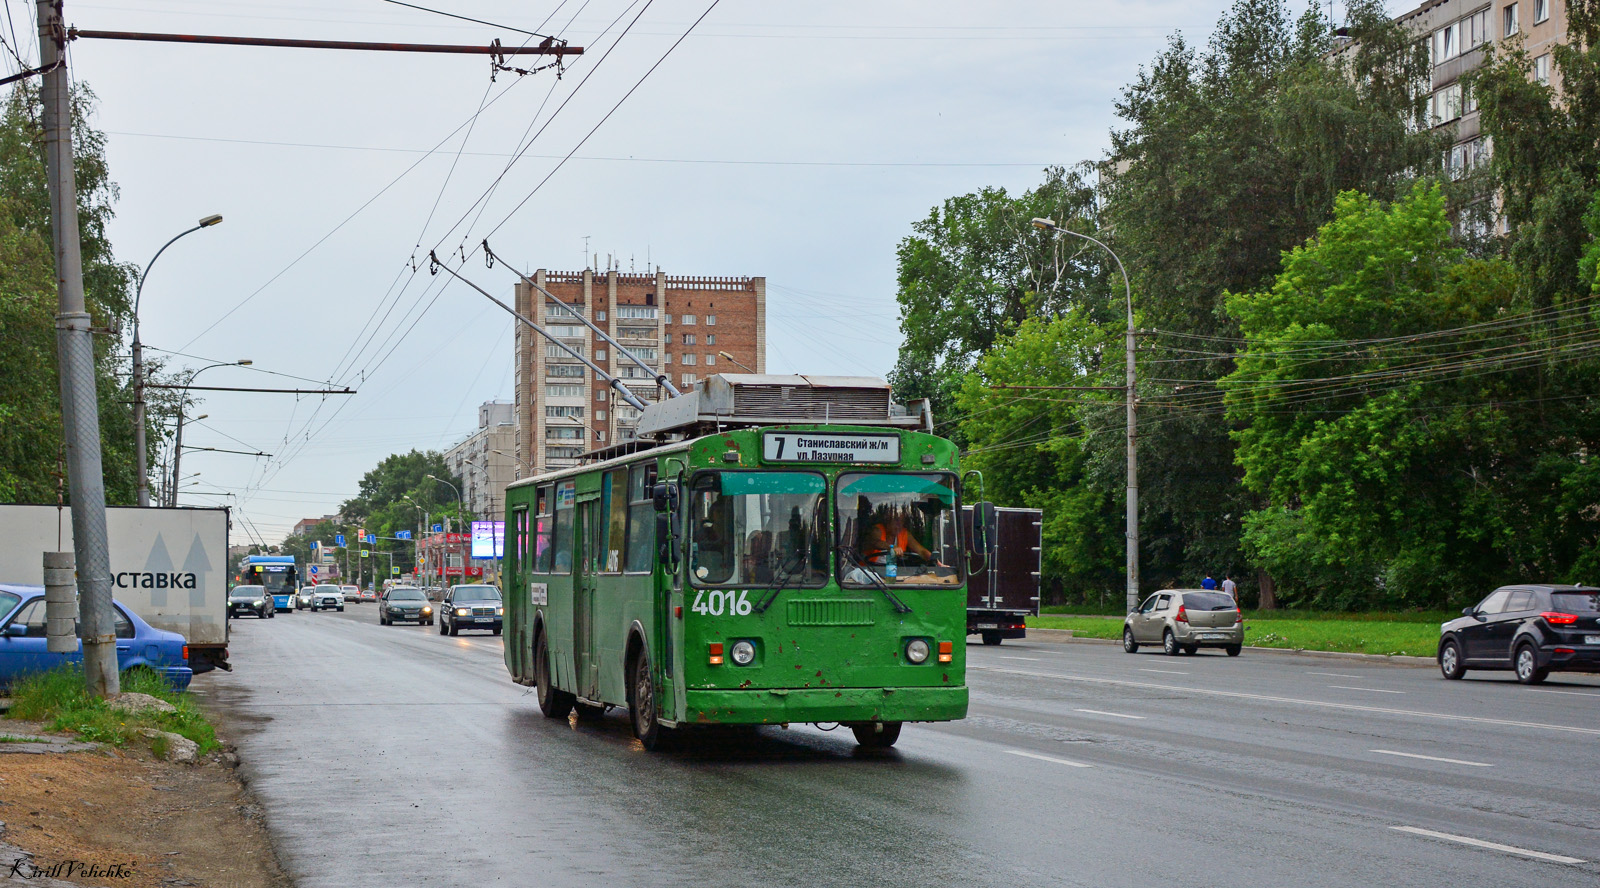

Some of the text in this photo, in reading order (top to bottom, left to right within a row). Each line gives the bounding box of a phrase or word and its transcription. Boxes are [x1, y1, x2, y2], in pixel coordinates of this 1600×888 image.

[774, 437, 786, 460] 7
[797, 437, 889, 450] Станиславский ж/м
[797, 451, 810, 461] ул.
[691, 589, 752, 616] 4016
